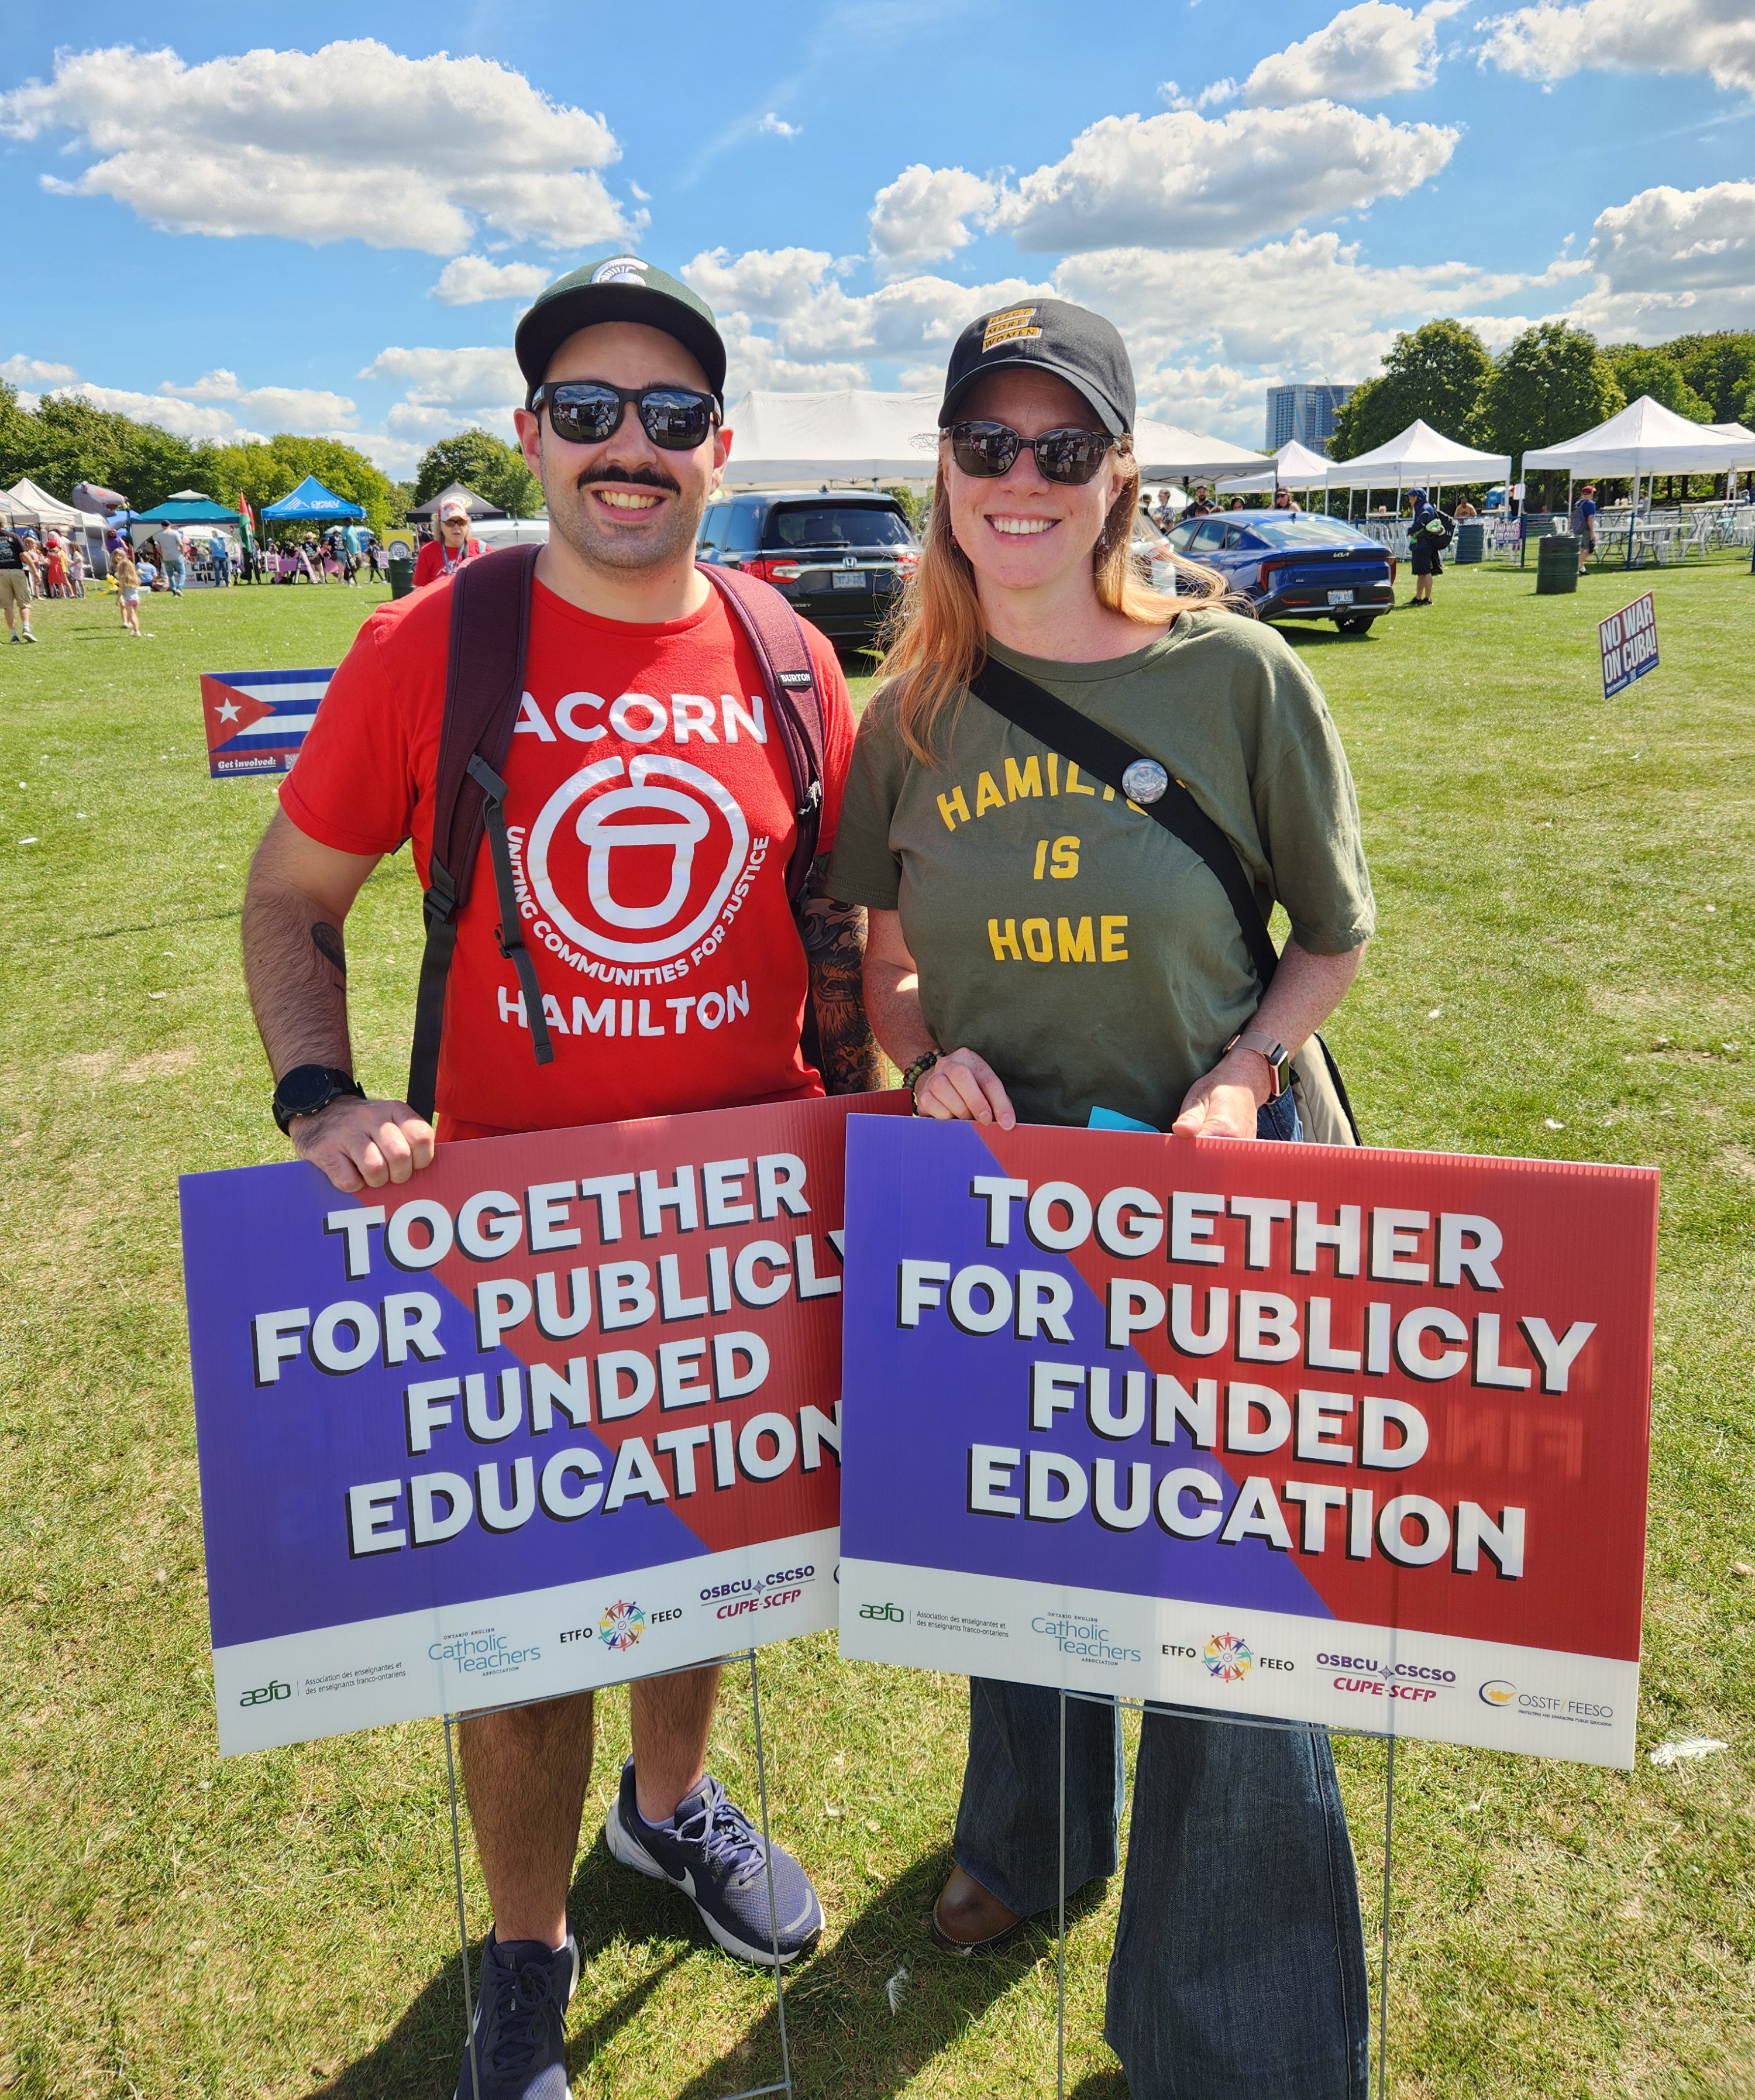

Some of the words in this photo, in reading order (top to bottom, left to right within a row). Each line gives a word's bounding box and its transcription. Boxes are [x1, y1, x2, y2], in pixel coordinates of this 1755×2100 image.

[985, 329, 1035, 348] WOMEN
[987, 320, 1022, 335] MORE
[1496, 532, 1503, 540] ON
[1601, 616, 1622, 654] NO
[1622, 596, 1653, 640] WAR
[1604, 648, 1622, 684] ON
[1623, 625, 1657, 672] CUBA!
[780, 673, 811, 682] BURTON
[513, 691, 768, 744] ACORN
[218, 760, 233, 769] Get
[235, 757, 276, 768] involved:
[937, 752, 1186, 832] HAMIL
[1033, 836, 1080, 880] IS
[506, 826, 538, 920] UNITING
[533, 920, 690, 987] COMMUNITIES
[692, 925, 727, 967] FOR
[721, 834, 769, 924] JUSTICE
[987, 915, 1128, 963] HOME
[497, 979, 750, 1037] HAMILTON
[324, 1152, 811, 1281] TOGETHER
[971, 1174, 1504, 1291] TOGETHER
[252, 1291, 448, 1388] FOR
[897, 1258, 1075, 1342] FOR
[1106, 1276, 1598, 1395] PUBLICLY
[404, 1330, 770, 1457] FUNDED
[1030, 1360, 1429, 1472] FUNDED
[347, 1400, 842, 1560] EDUCATION
[966, 1443, 1526, 1581] EDUCATION
[700, 1579, 752, 1601] OSBCU
[766, 1565, 815, 1586] CSCSO
[651, 1608, 683, 1624] FEEO
[916, 1611, 949, 1622] Association
[961, 1618, 999, 1629] enseignantes
[928, 1621, 961, 1631] enseignants
[963, 1625, 1009, 1638] franco-ontariens
[1031, 1617, 1109, 1641] Catholic
[443, 1632, 469, 1640] ONTARIO
[471, 1627, 495, 1635] ENGLISH
[560, 1627, 593, 1644] ETFO
[428, 1634, 508, 1661] Catholic
[453, 1647, 541, 1673] Teachers
[1054, 1635, 1141, 1662] Teachers
[1162, 1644, 1196, 1658] ETFO
[304, 1674, 340, 1686] Association
[342, 1671, 353, 1679] des
[354, 1663, 394, 1677] enseignantes
[482, 1666, 519, 1676] ASSOCIATION
[1081, 1658, 1119, 1666] ASSOCIATION
[1260, 1657, 1295, 1671] FEEO
[1316, 1653, 1378, 1672] OSBCU
[1395, 1663, 1456, 1682] CSCSO
[305, 1686, 316, 1695] des
[318, 1680, 355, 1693] enseignants
[356, 1670, 407, 1686] franco-ontariens
